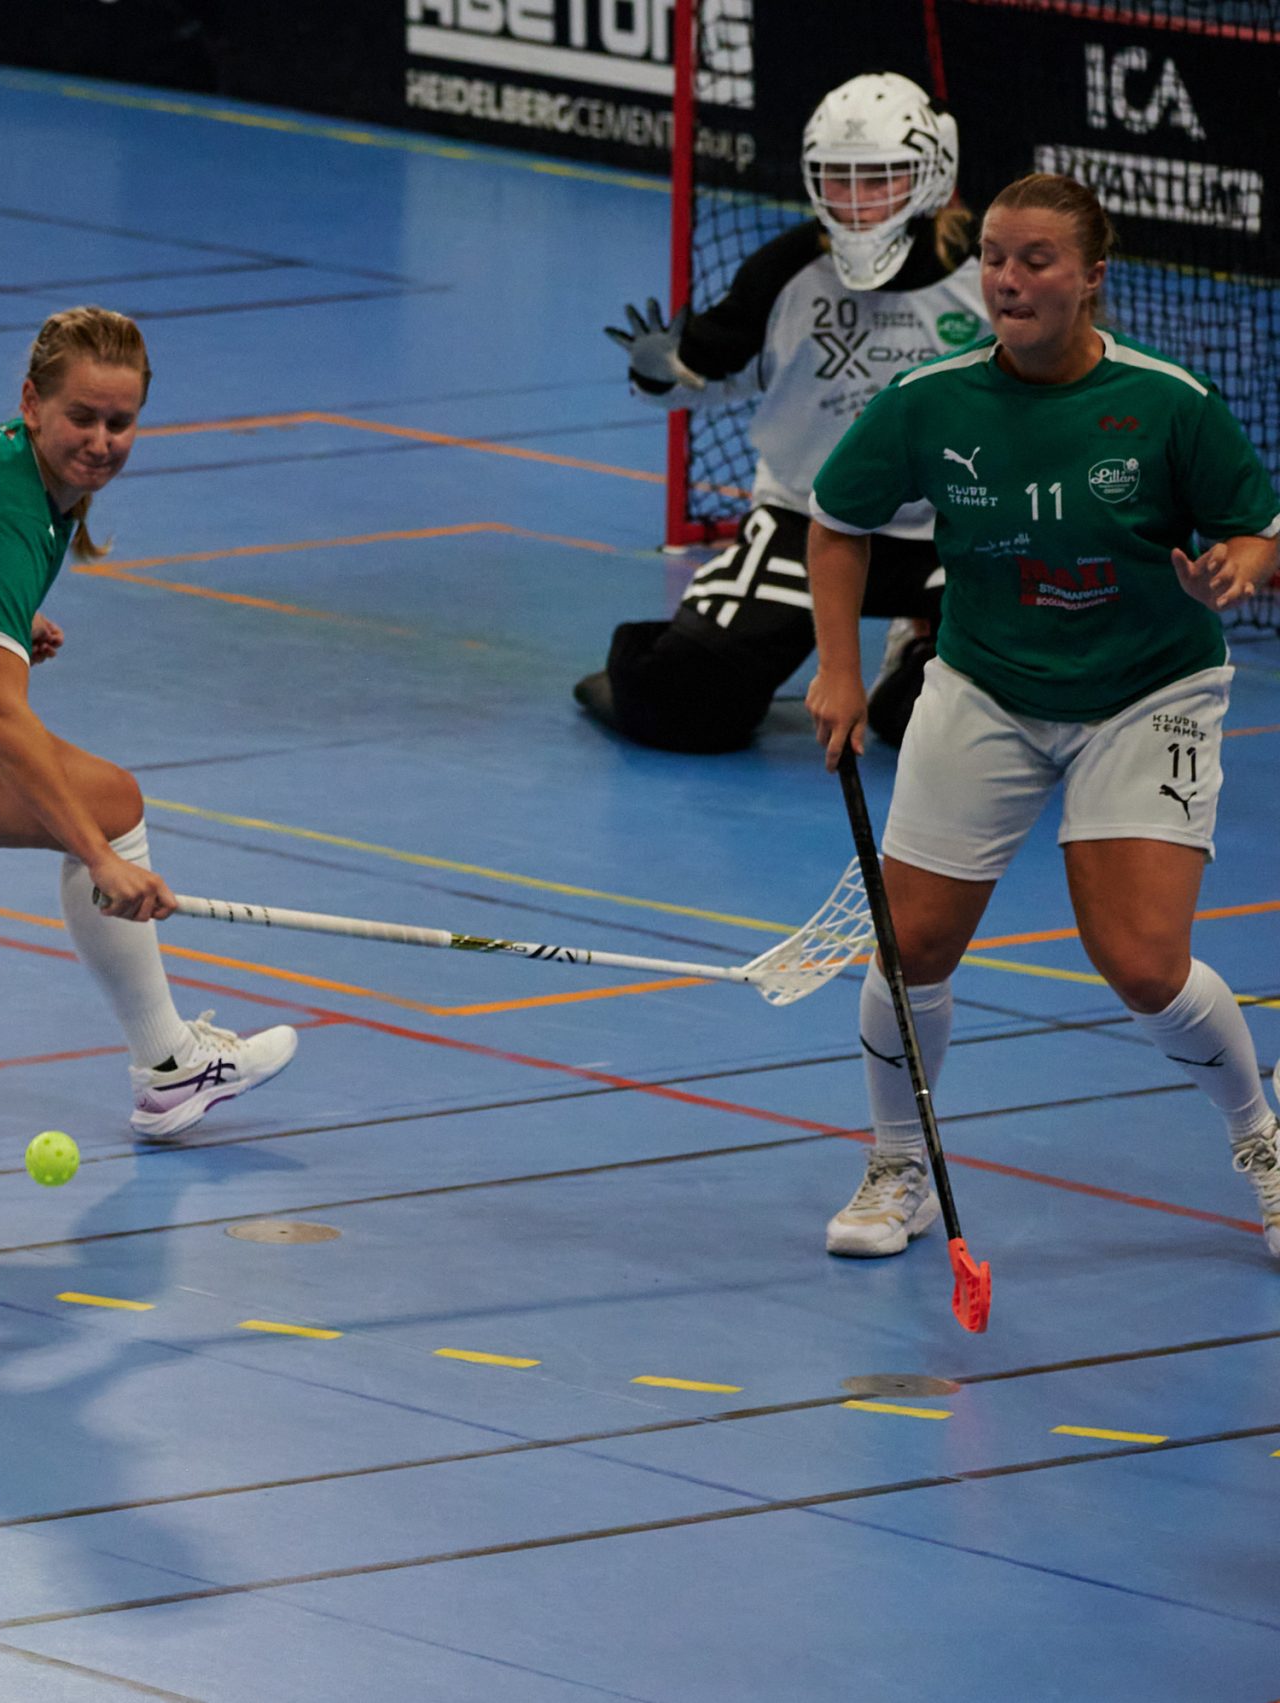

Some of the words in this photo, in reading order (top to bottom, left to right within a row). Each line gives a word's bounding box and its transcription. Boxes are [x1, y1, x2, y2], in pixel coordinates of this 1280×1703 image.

[1085, 43, 1206, 141] ICA
[812, 297, 857, 328] 20
[1025, 483, 1062, 520] 11
[1017, 557, 1117, 589] MAXI
[1168, 743, 1196, 782] 11
